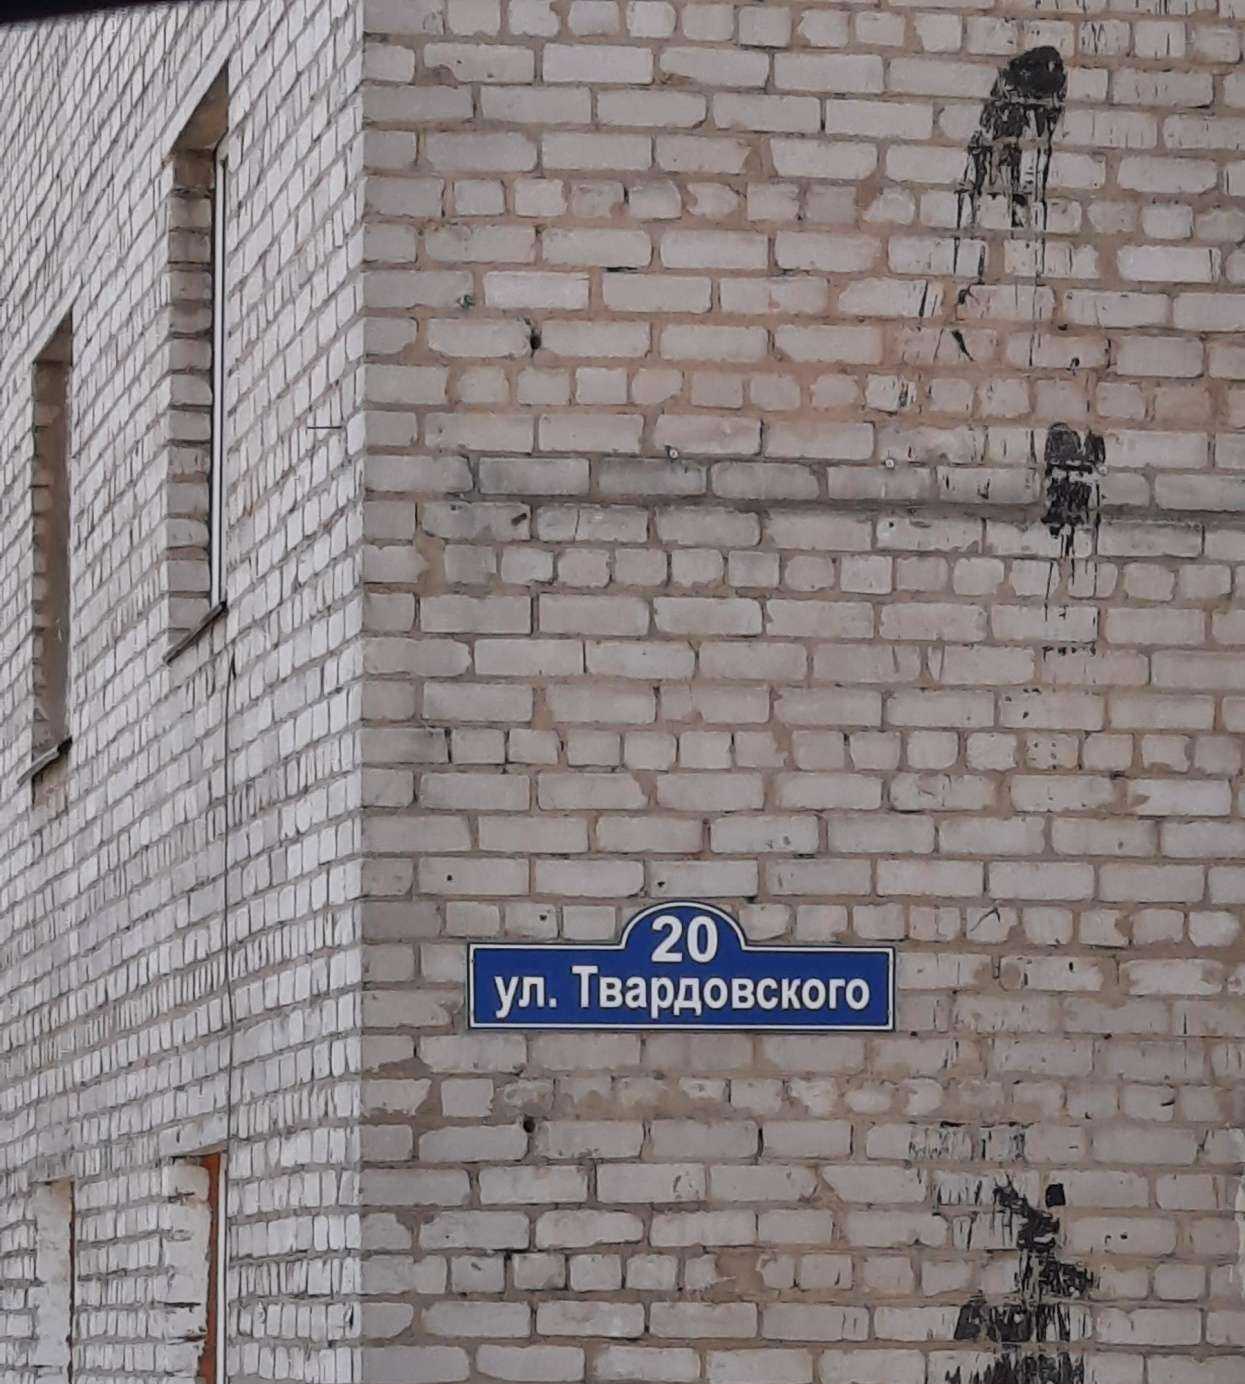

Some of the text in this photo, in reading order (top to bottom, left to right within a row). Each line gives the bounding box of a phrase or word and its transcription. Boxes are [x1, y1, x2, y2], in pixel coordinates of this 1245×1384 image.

[650, 914, 719, 963] 20
[494, 964, 871, 1019] ул. Твардовского
